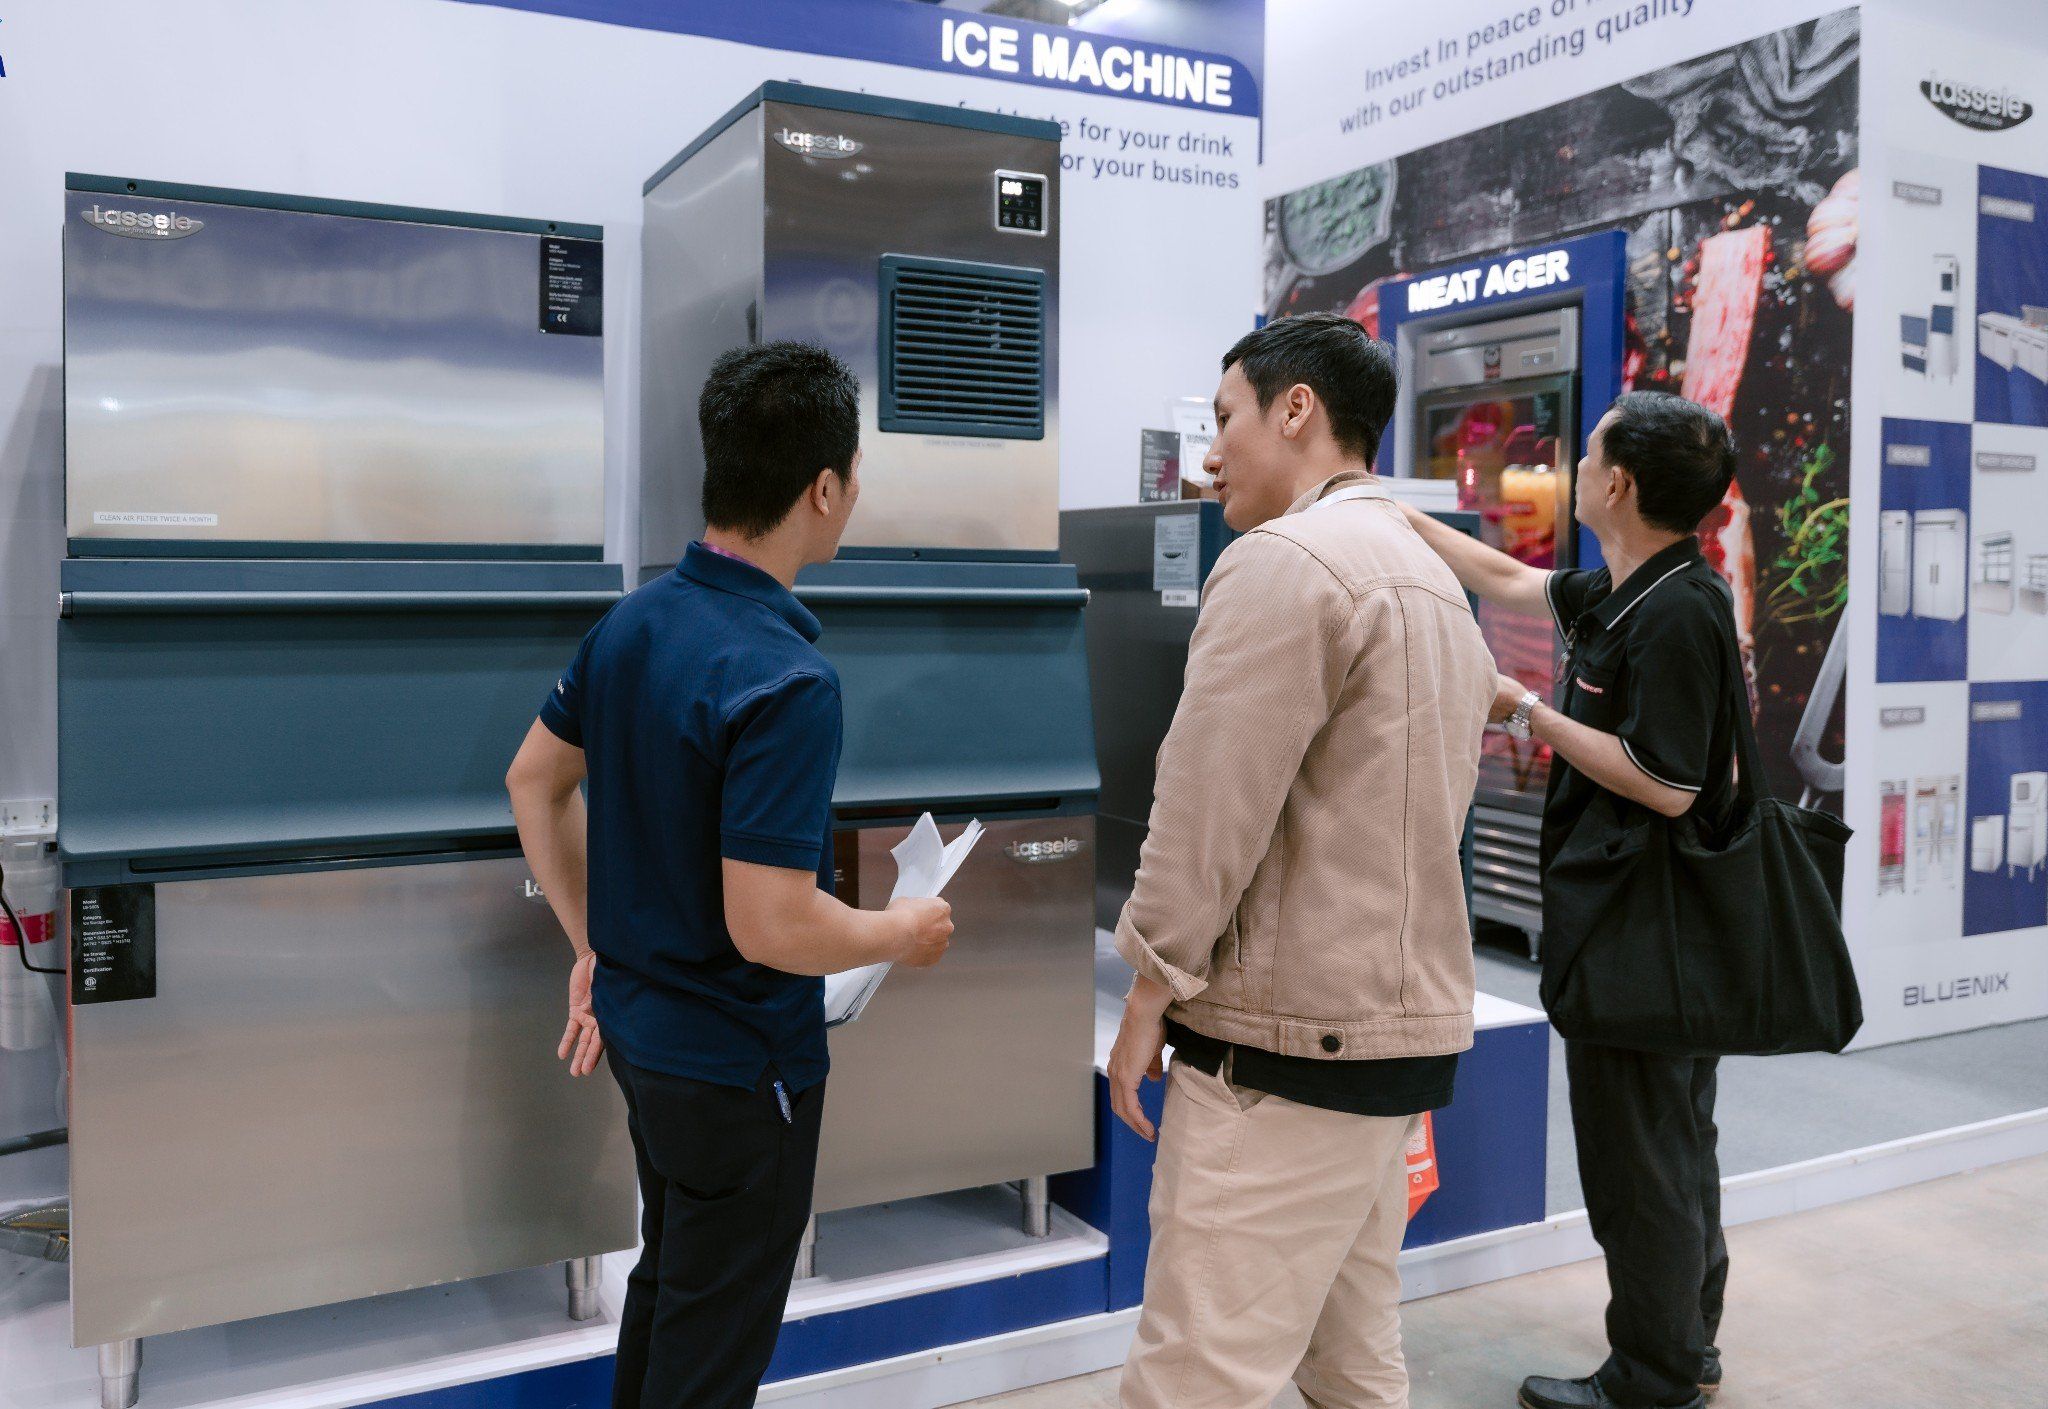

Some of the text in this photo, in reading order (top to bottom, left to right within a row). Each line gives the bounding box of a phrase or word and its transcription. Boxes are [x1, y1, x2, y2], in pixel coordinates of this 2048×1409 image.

[941, 18, 1233, 107] ICE MACHINE
[1364, 48, 1432, 92] Invest
[1437, 37, 1459, 63] In
[1467, 4, 1542, 59] peace
[1339, 101, 1382, 135] with
[1388, 85, 1424, 118] our
[1432, 25, 1586, 101] outstanding
[1079, 116, 1112, 142] for
[1118, 128, 1171, 151] your
[1178, 134, 1234, 158] drink
[1060, 153, 1240, 190] or your busines
[93, 204, 194, 232] Lassele
[1407, 249, 1571, 314] MEAT AGER
[1012, 836, 1079, 857] Lassele
[1903, 972, 2009, 1006] BLUENIX
